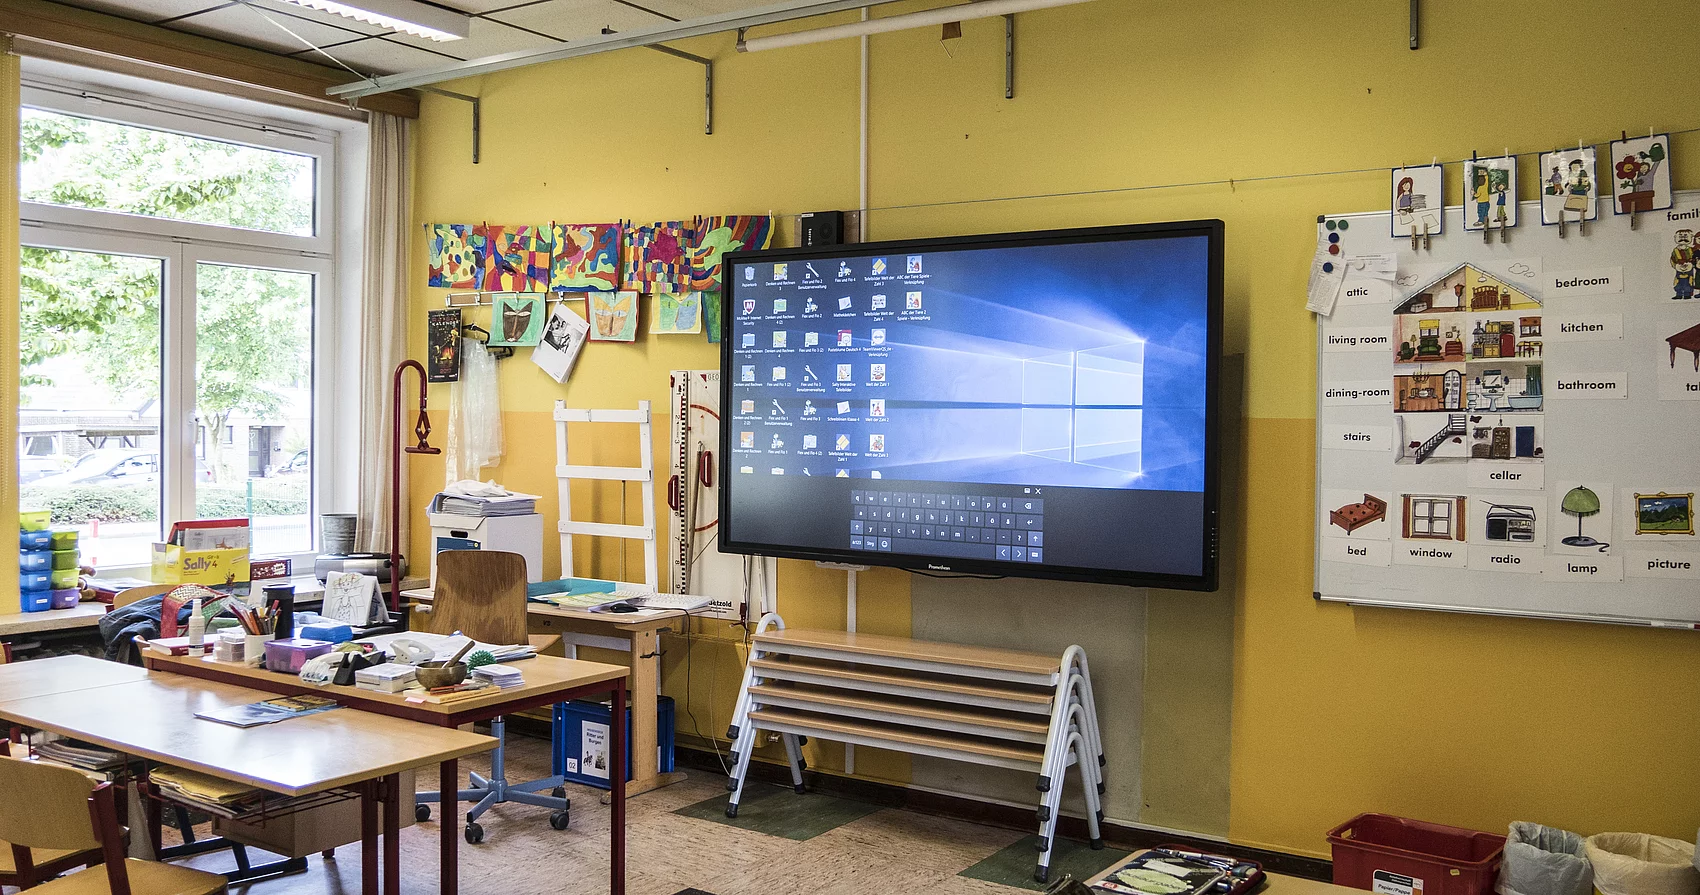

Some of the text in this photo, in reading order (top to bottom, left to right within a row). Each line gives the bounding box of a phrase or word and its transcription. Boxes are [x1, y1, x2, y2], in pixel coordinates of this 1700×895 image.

[1667, 208, 1700, 221] famil
[1555, 276, 1610, 288] bedroom
[1346, 287, 1368, 297] attic
[1560, 322, 1604, 333] kitchen
[1328, 336, 1357, 346] living
[1557, 380, 1616, 390] bathroom
[1686, 382, 1700, 392] ta
[1325, 388, 1390, 399] dining-room
[1343, 432, 1371, 442] stairs
[1489, 470, 1522, 481] cellar
[1347, 546, 1367, 556] bed
[1409, 547, 1453, 559] window
[184, 556, 212, 571] Sally
[1490, 554, 1521, 565] radio
[1647, 558, 1691, 571] picture
[1567, 562, 1598, 575] lamp
